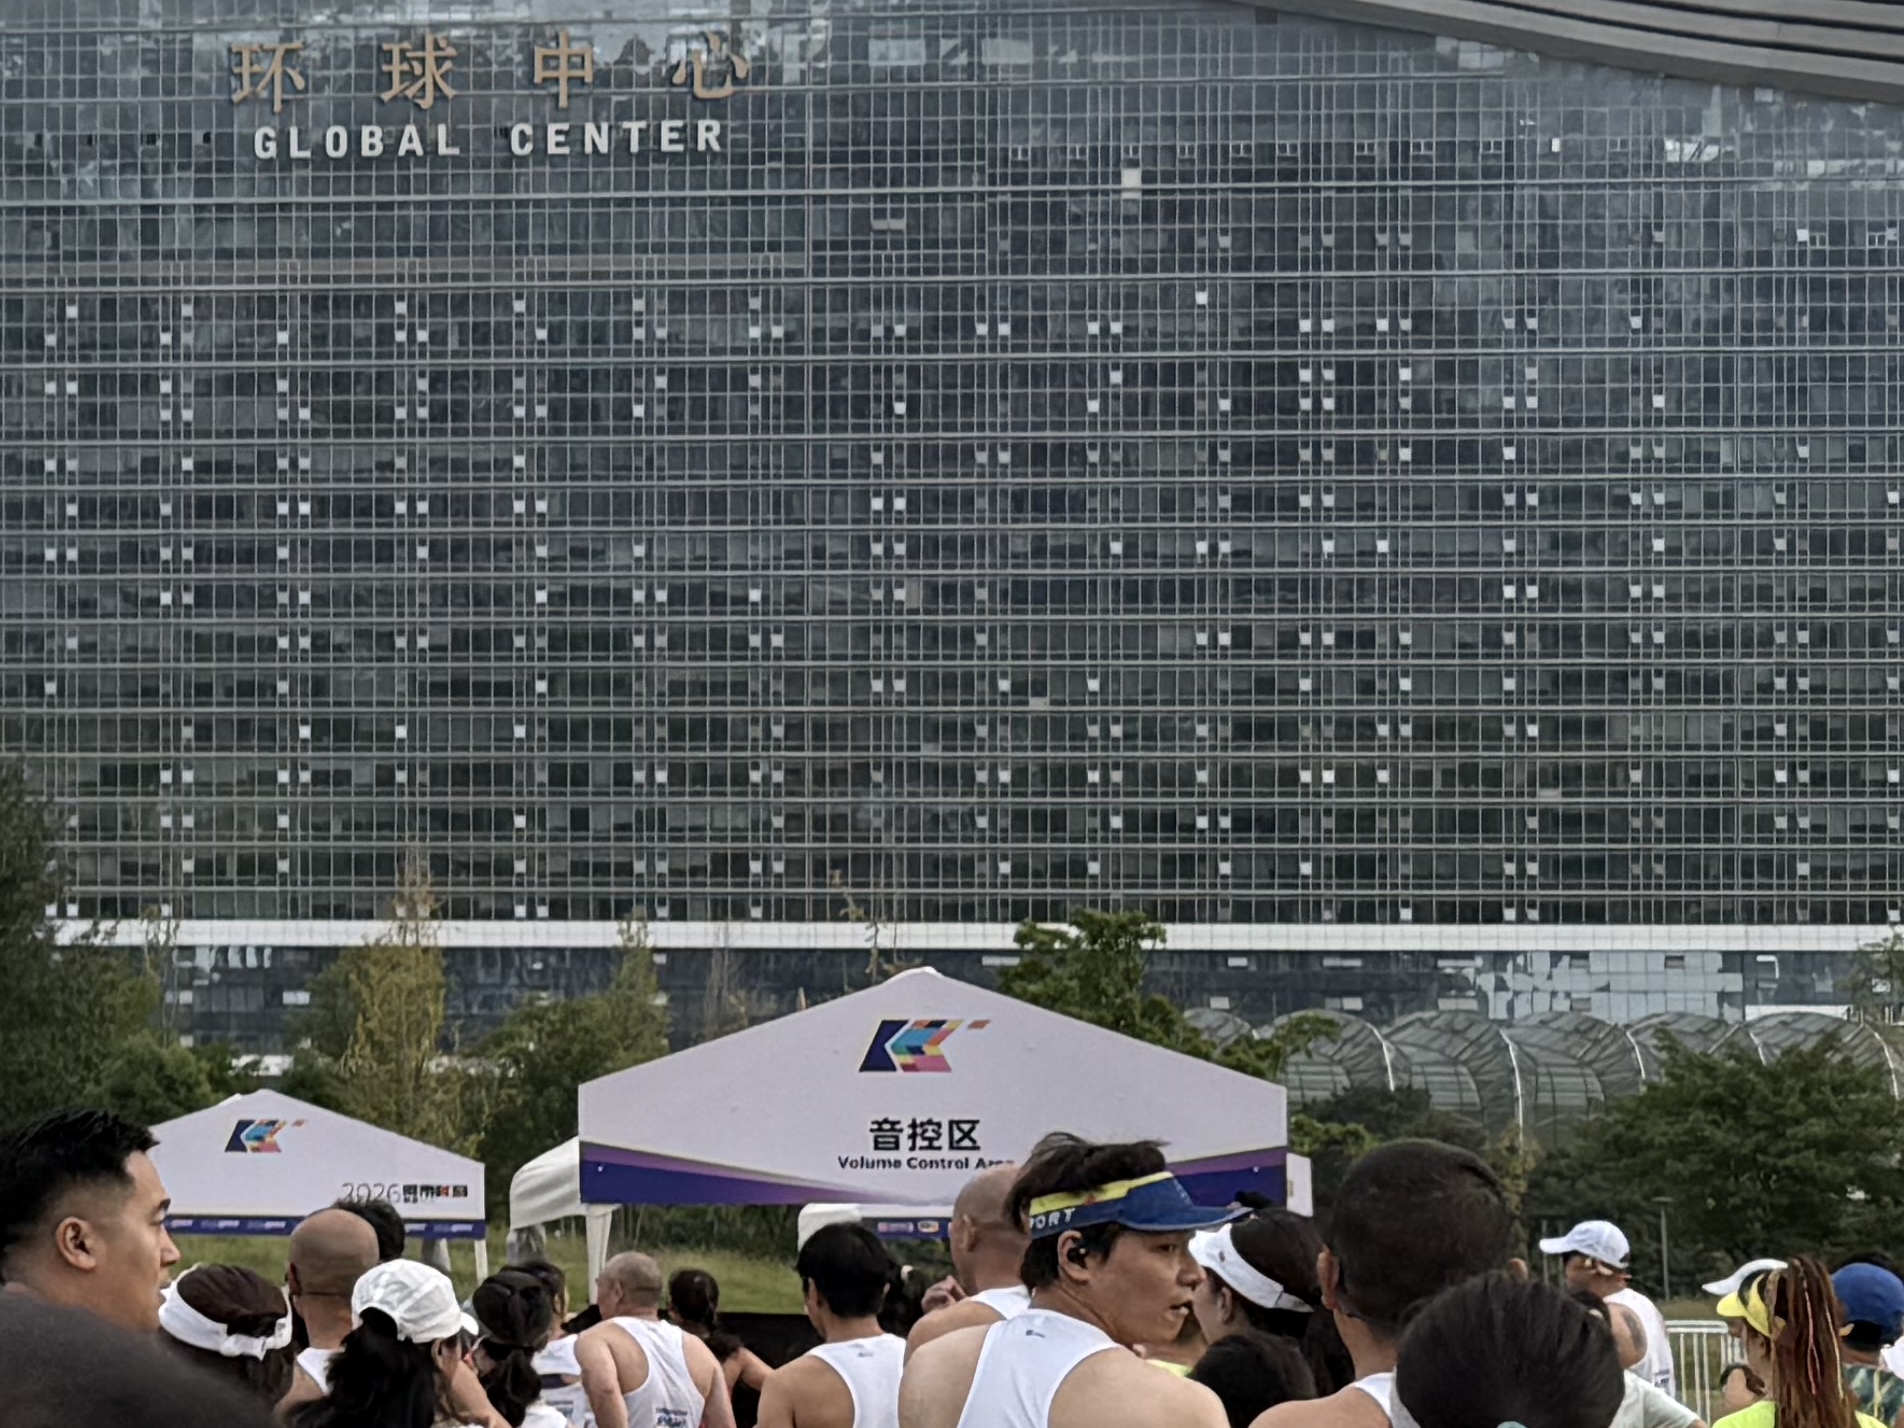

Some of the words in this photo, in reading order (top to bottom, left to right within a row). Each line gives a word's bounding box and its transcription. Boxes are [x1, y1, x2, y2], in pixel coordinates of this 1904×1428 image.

[230, 31, 749, 114] 环球中心
[254, 123, 460, 160] GLOBAL
[510, 119, 722, 157] CENTER
[869, 1118, 981, 1151] 音控区
[838, 1156, 902, 1169] Volume
[906, 1157, 969, 1169] Control
